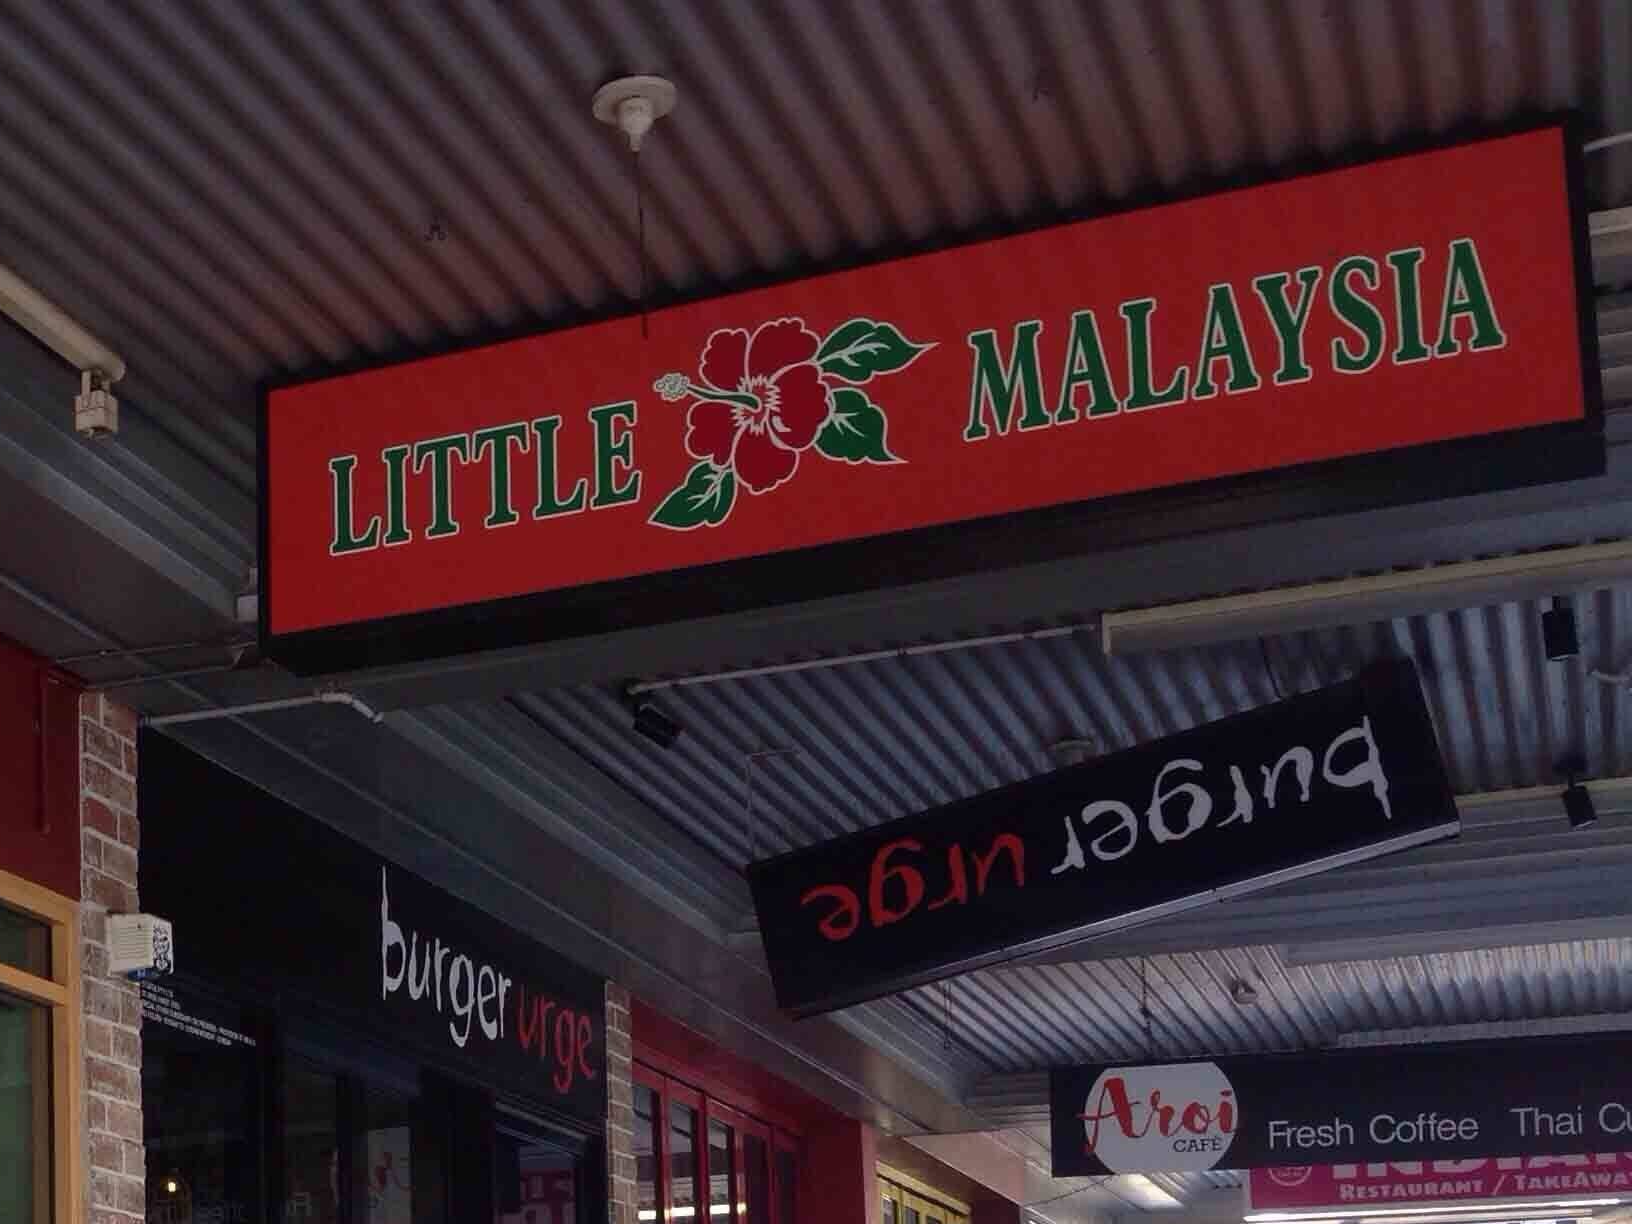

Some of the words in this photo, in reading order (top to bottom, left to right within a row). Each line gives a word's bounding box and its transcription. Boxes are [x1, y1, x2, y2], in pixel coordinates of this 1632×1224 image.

[329, 400, 642, 557] LITTLE
[963, 237, 1507, 442] MALAYSIA
[1051, 715, 1393, 875] burger
[801, 832, 1025, 941] urge
[381, 865, 512, 1048] burger
[516, 983, 595, 1094] urge
[1076, 1076, 1237, 1153] Aroi
[1268, 1118, 1355, 1150] Fresh
[1369, 1112, 1480, 1144] Coffee
[1510, 1105, 1584, 1137] Thai
